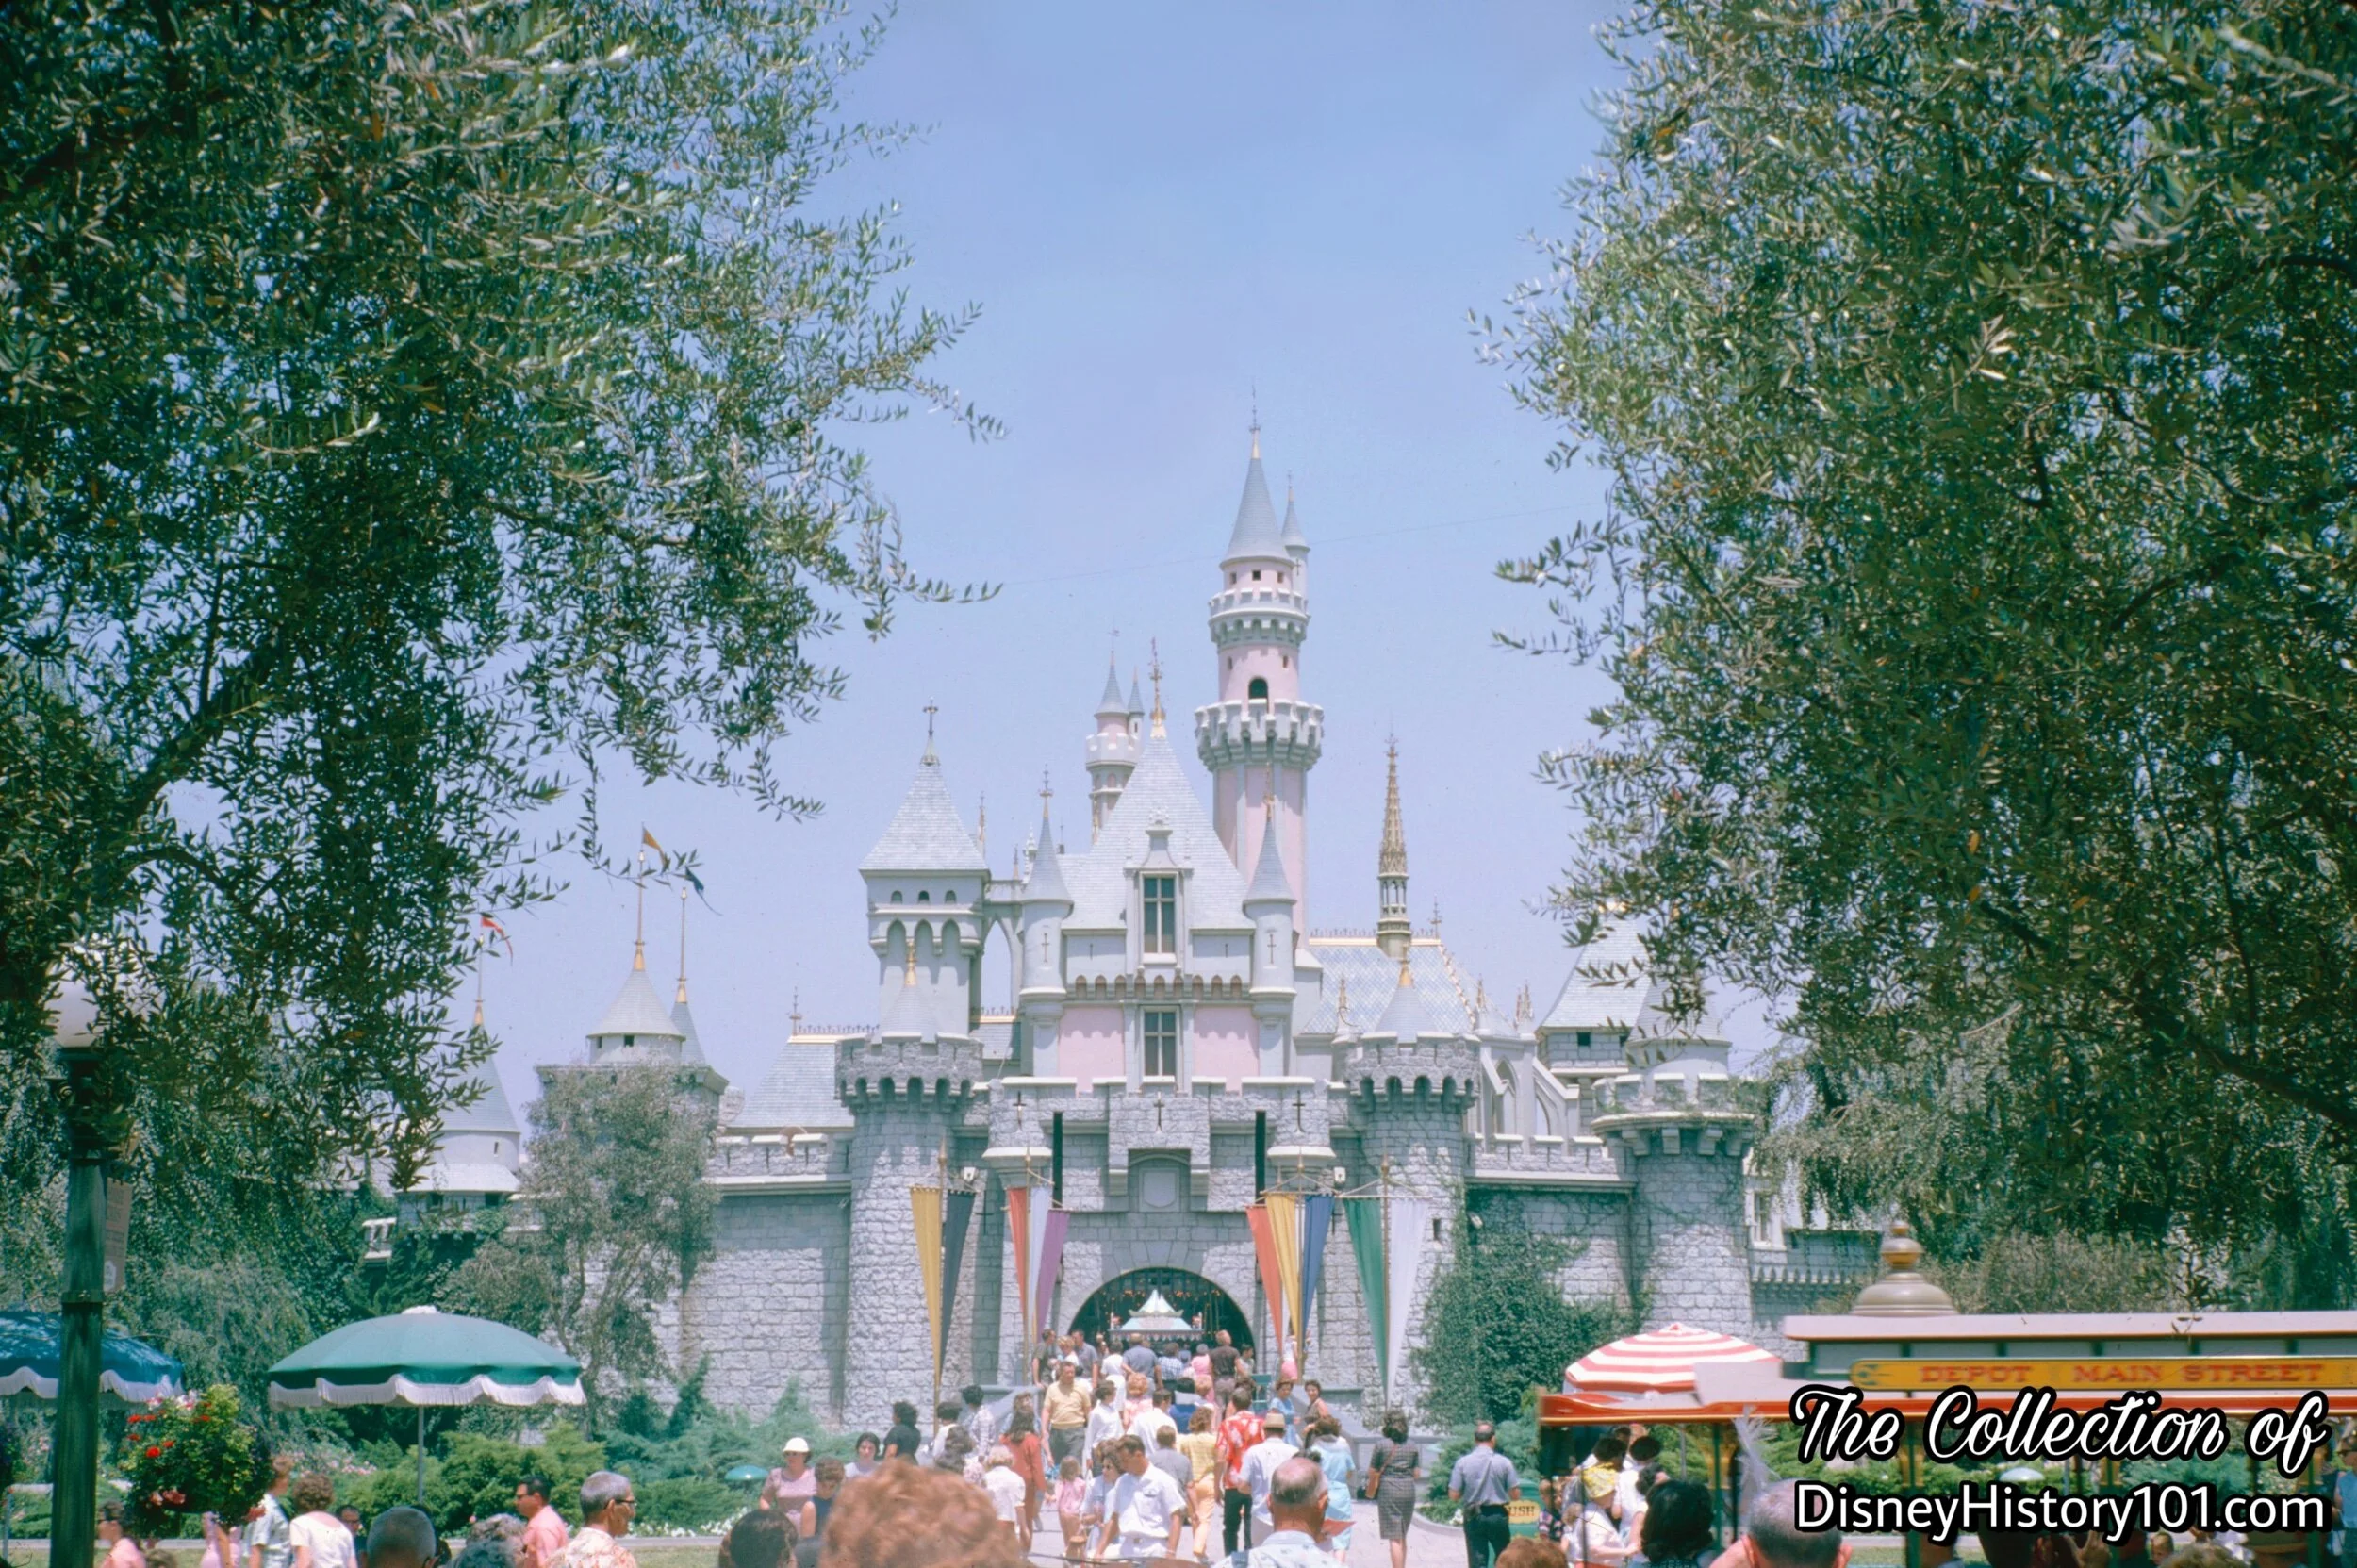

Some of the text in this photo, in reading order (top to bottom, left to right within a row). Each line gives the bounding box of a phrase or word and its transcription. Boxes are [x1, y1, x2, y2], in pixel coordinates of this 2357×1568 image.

[1920, 1364, 2323, 1383] DEPOT MAIN STREET
